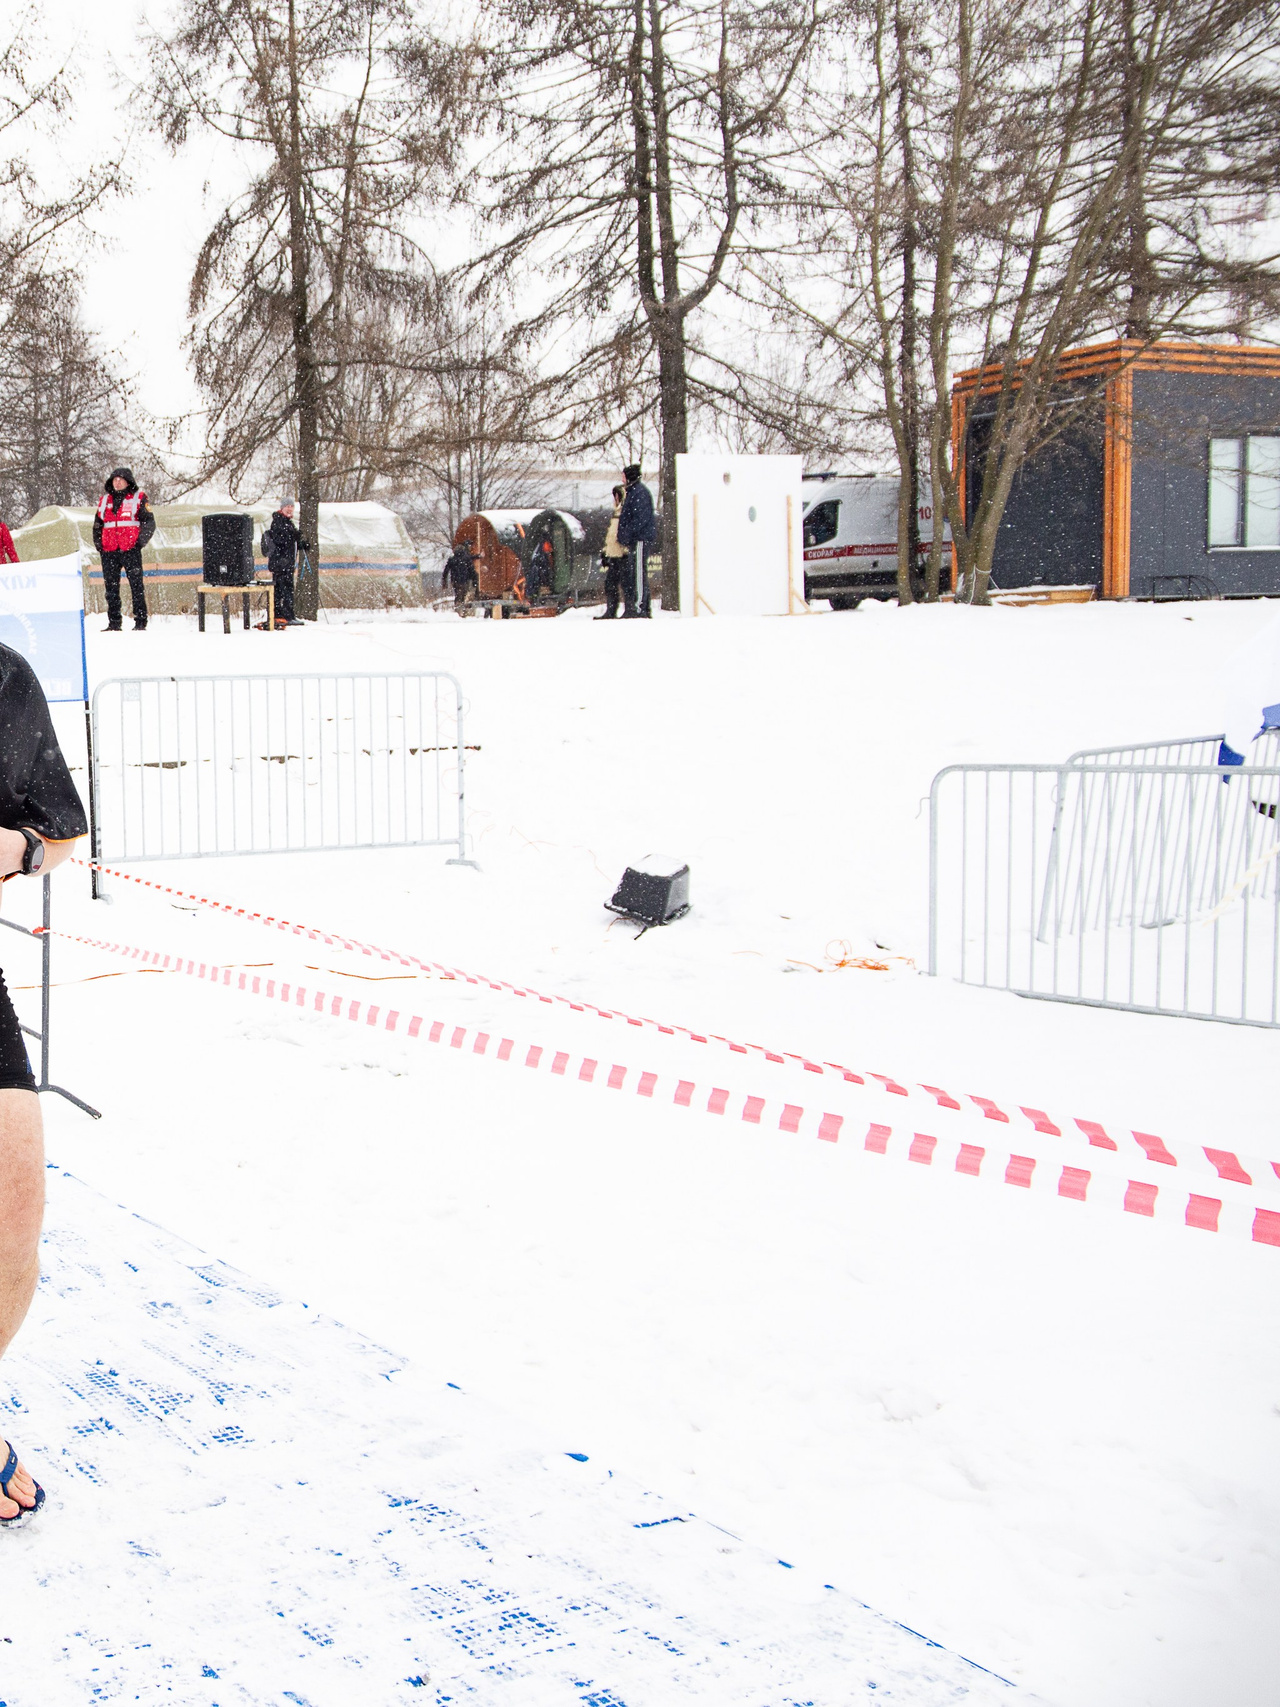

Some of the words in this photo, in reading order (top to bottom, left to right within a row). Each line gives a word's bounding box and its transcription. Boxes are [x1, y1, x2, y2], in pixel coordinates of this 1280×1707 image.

[918, 506, 933, 520] 10
[808, 548, 834, 559] СКОРАЯ
[853, 545, 899, 555] МЕДИЦИНСКА
